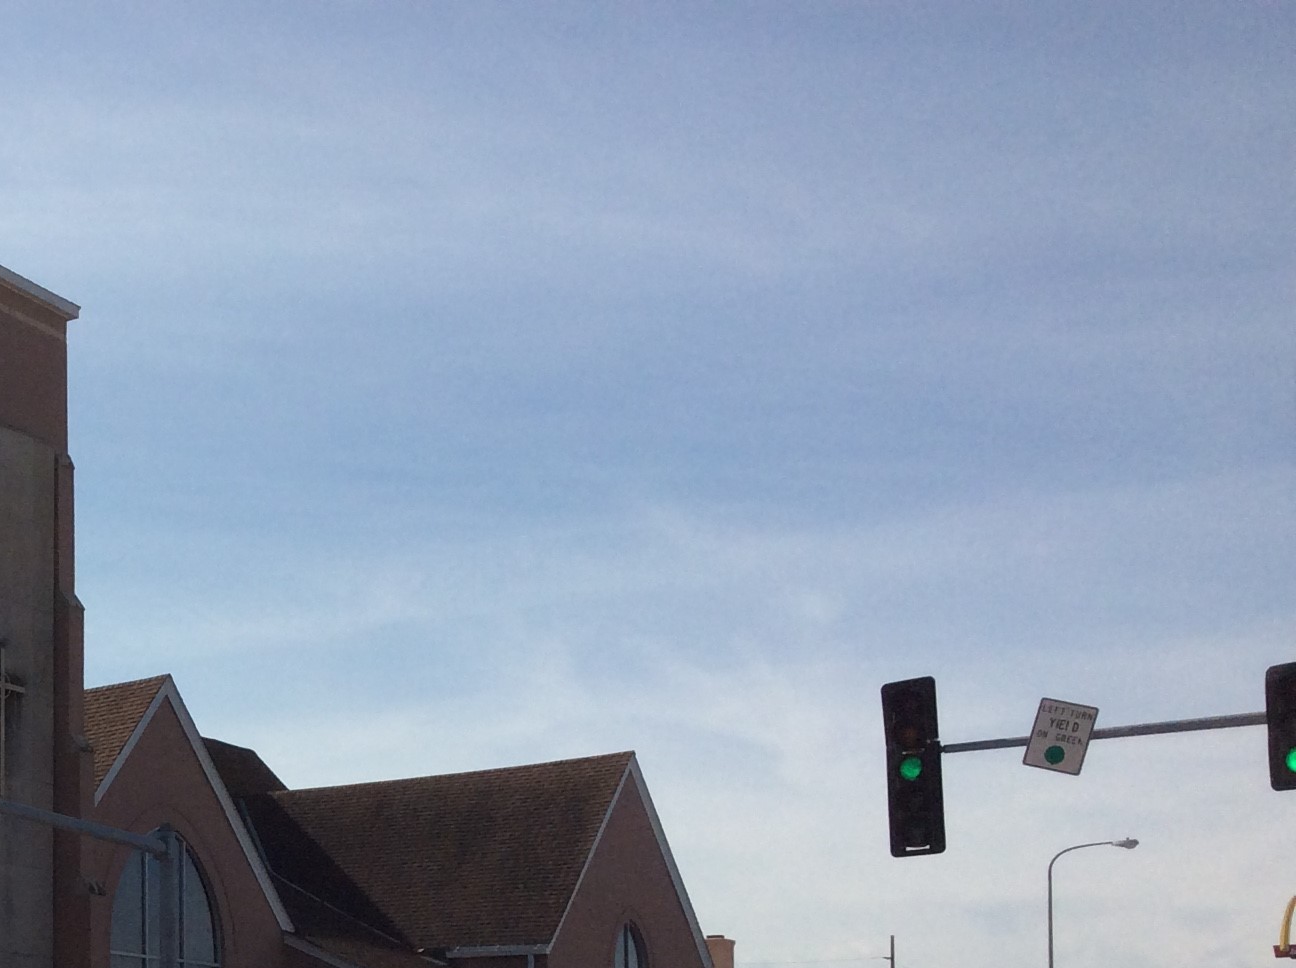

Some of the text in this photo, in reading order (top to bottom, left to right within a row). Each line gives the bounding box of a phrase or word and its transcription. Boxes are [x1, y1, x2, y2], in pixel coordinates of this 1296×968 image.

[1041, 703, 1093, 721] LEFT TURN
[1049, 716, 1080, 733] YIELD
[1036, 729, 1083, 746] ON GREEN
